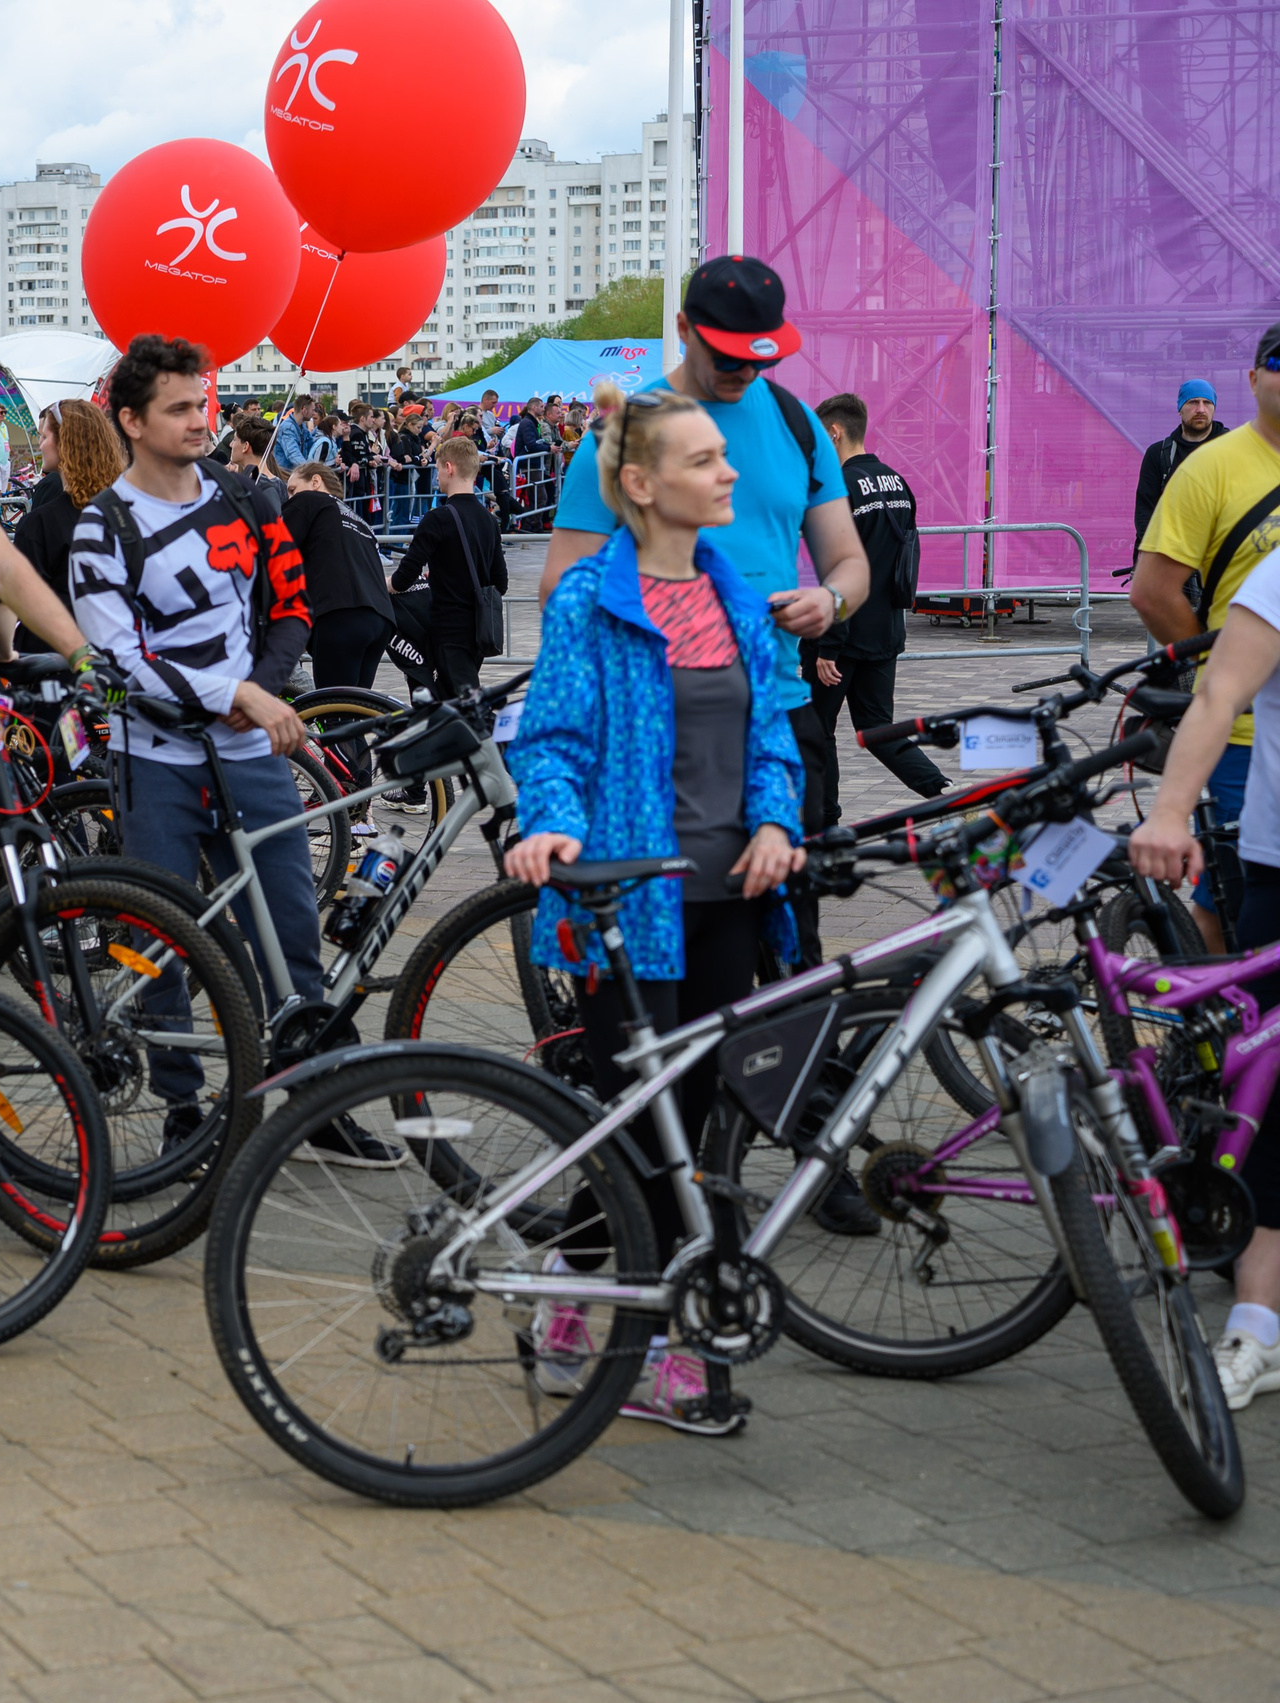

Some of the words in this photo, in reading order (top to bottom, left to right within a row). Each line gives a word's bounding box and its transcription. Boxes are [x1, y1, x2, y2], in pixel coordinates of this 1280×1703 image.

[270, 104, 335, 133] MEGATOP
[300, 243, 340, 261] ATOP
[144, 259, 228, 285] MEGATOP
[857, 475, 904, 496] BEARUS
[389, 634, 425, 665] LARUS
[354, 836, 449, 976] GIANT
[236, 1346, 310, 1444] MAXXIS
